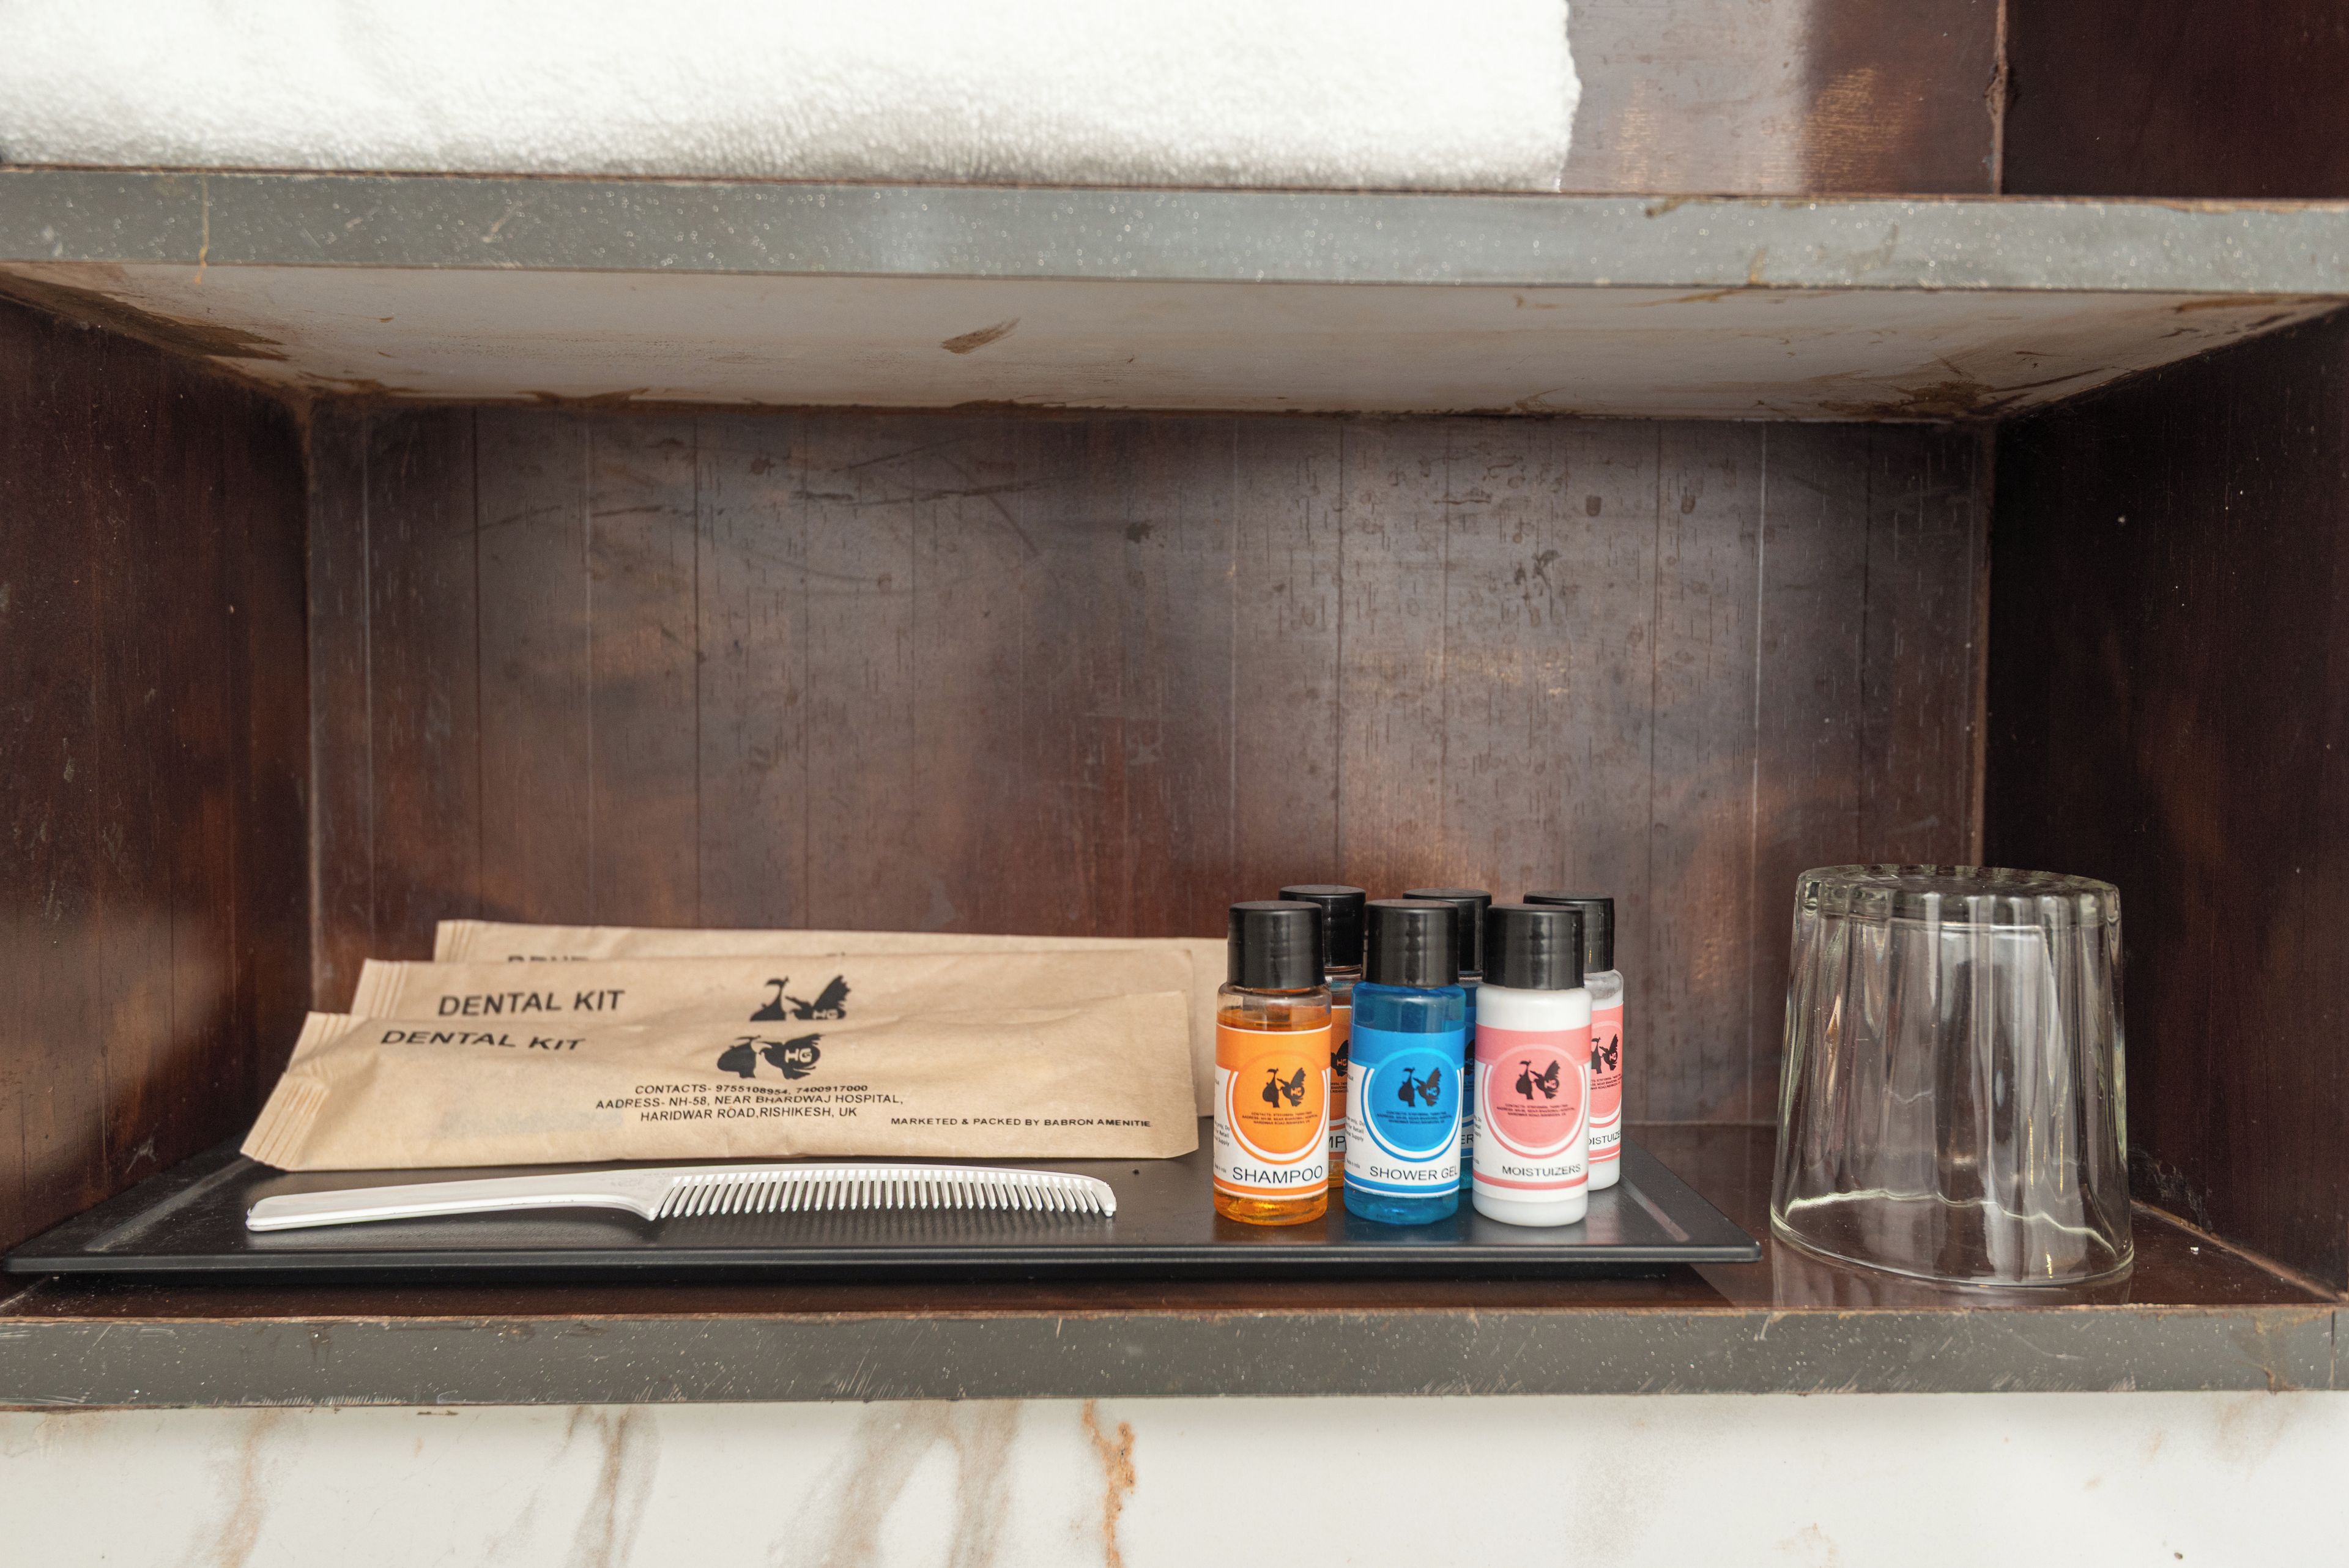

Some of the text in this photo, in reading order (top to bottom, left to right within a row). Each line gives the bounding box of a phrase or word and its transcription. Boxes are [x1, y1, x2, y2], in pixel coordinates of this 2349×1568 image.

[438, 989, 625, 1017] DENTAL KIT
[380, 1030, 586, 1050] DENTAL KIT
[785, 1048, 812, 1063] HG
[634, 1084, 711, 1094] CONTACTS-
[796, 1085, 868, 1094] 7400917000
[596, 1094, 903, 1109] AADRESS- NH-58, NEAR BHARDWAJ HOSPITAL,
[640, 1109, 713, 1121] HARIDWAR
[839, 1107, 857, 1117] UK
[1233, 1165, 1323, 1184] SHAMPOO
[1370, 1165, 1458, 1180] SHOWER GEL
[1502, 1164, 1581, 1176] MOISTUIZERS
